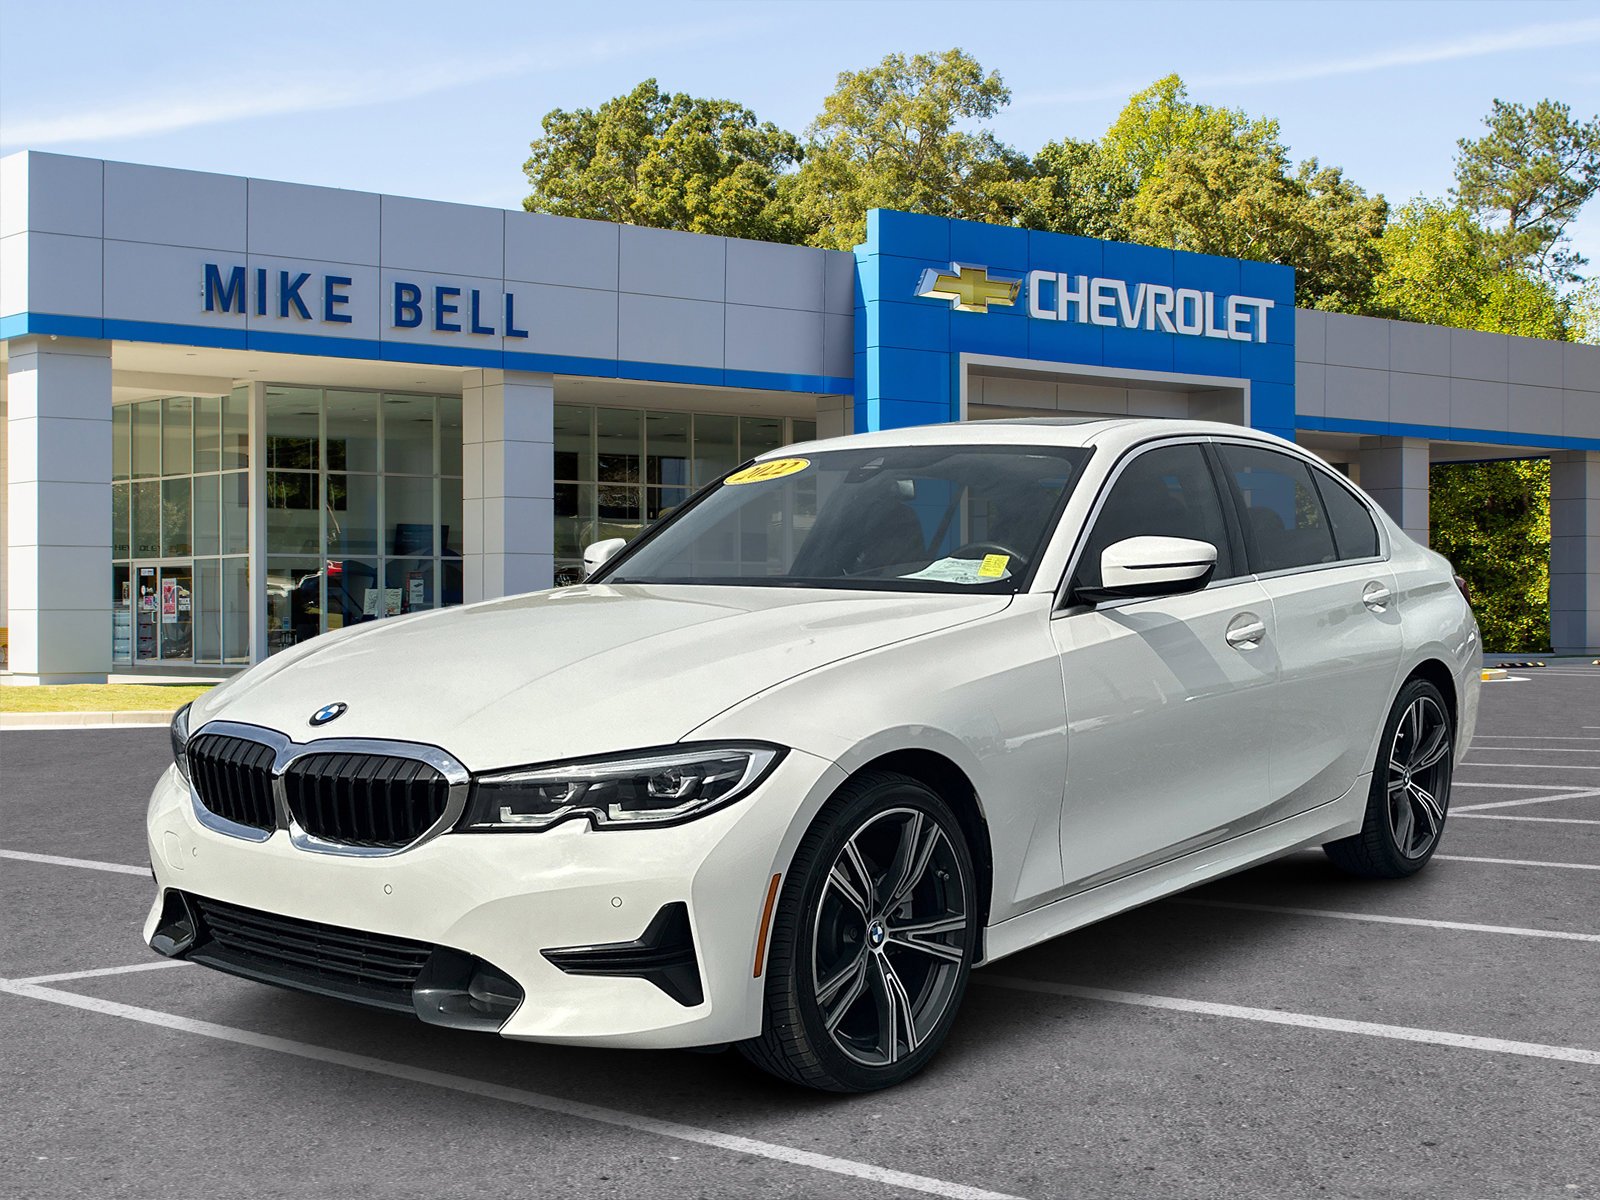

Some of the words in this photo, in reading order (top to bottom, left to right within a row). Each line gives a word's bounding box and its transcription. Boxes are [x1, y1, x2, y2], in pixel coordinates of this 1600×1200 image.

[204, 263, 353, 324] MIKE
[391, 281, 529, 339] BELL
[1026, 269, 1275, 343] CHEVROLET
